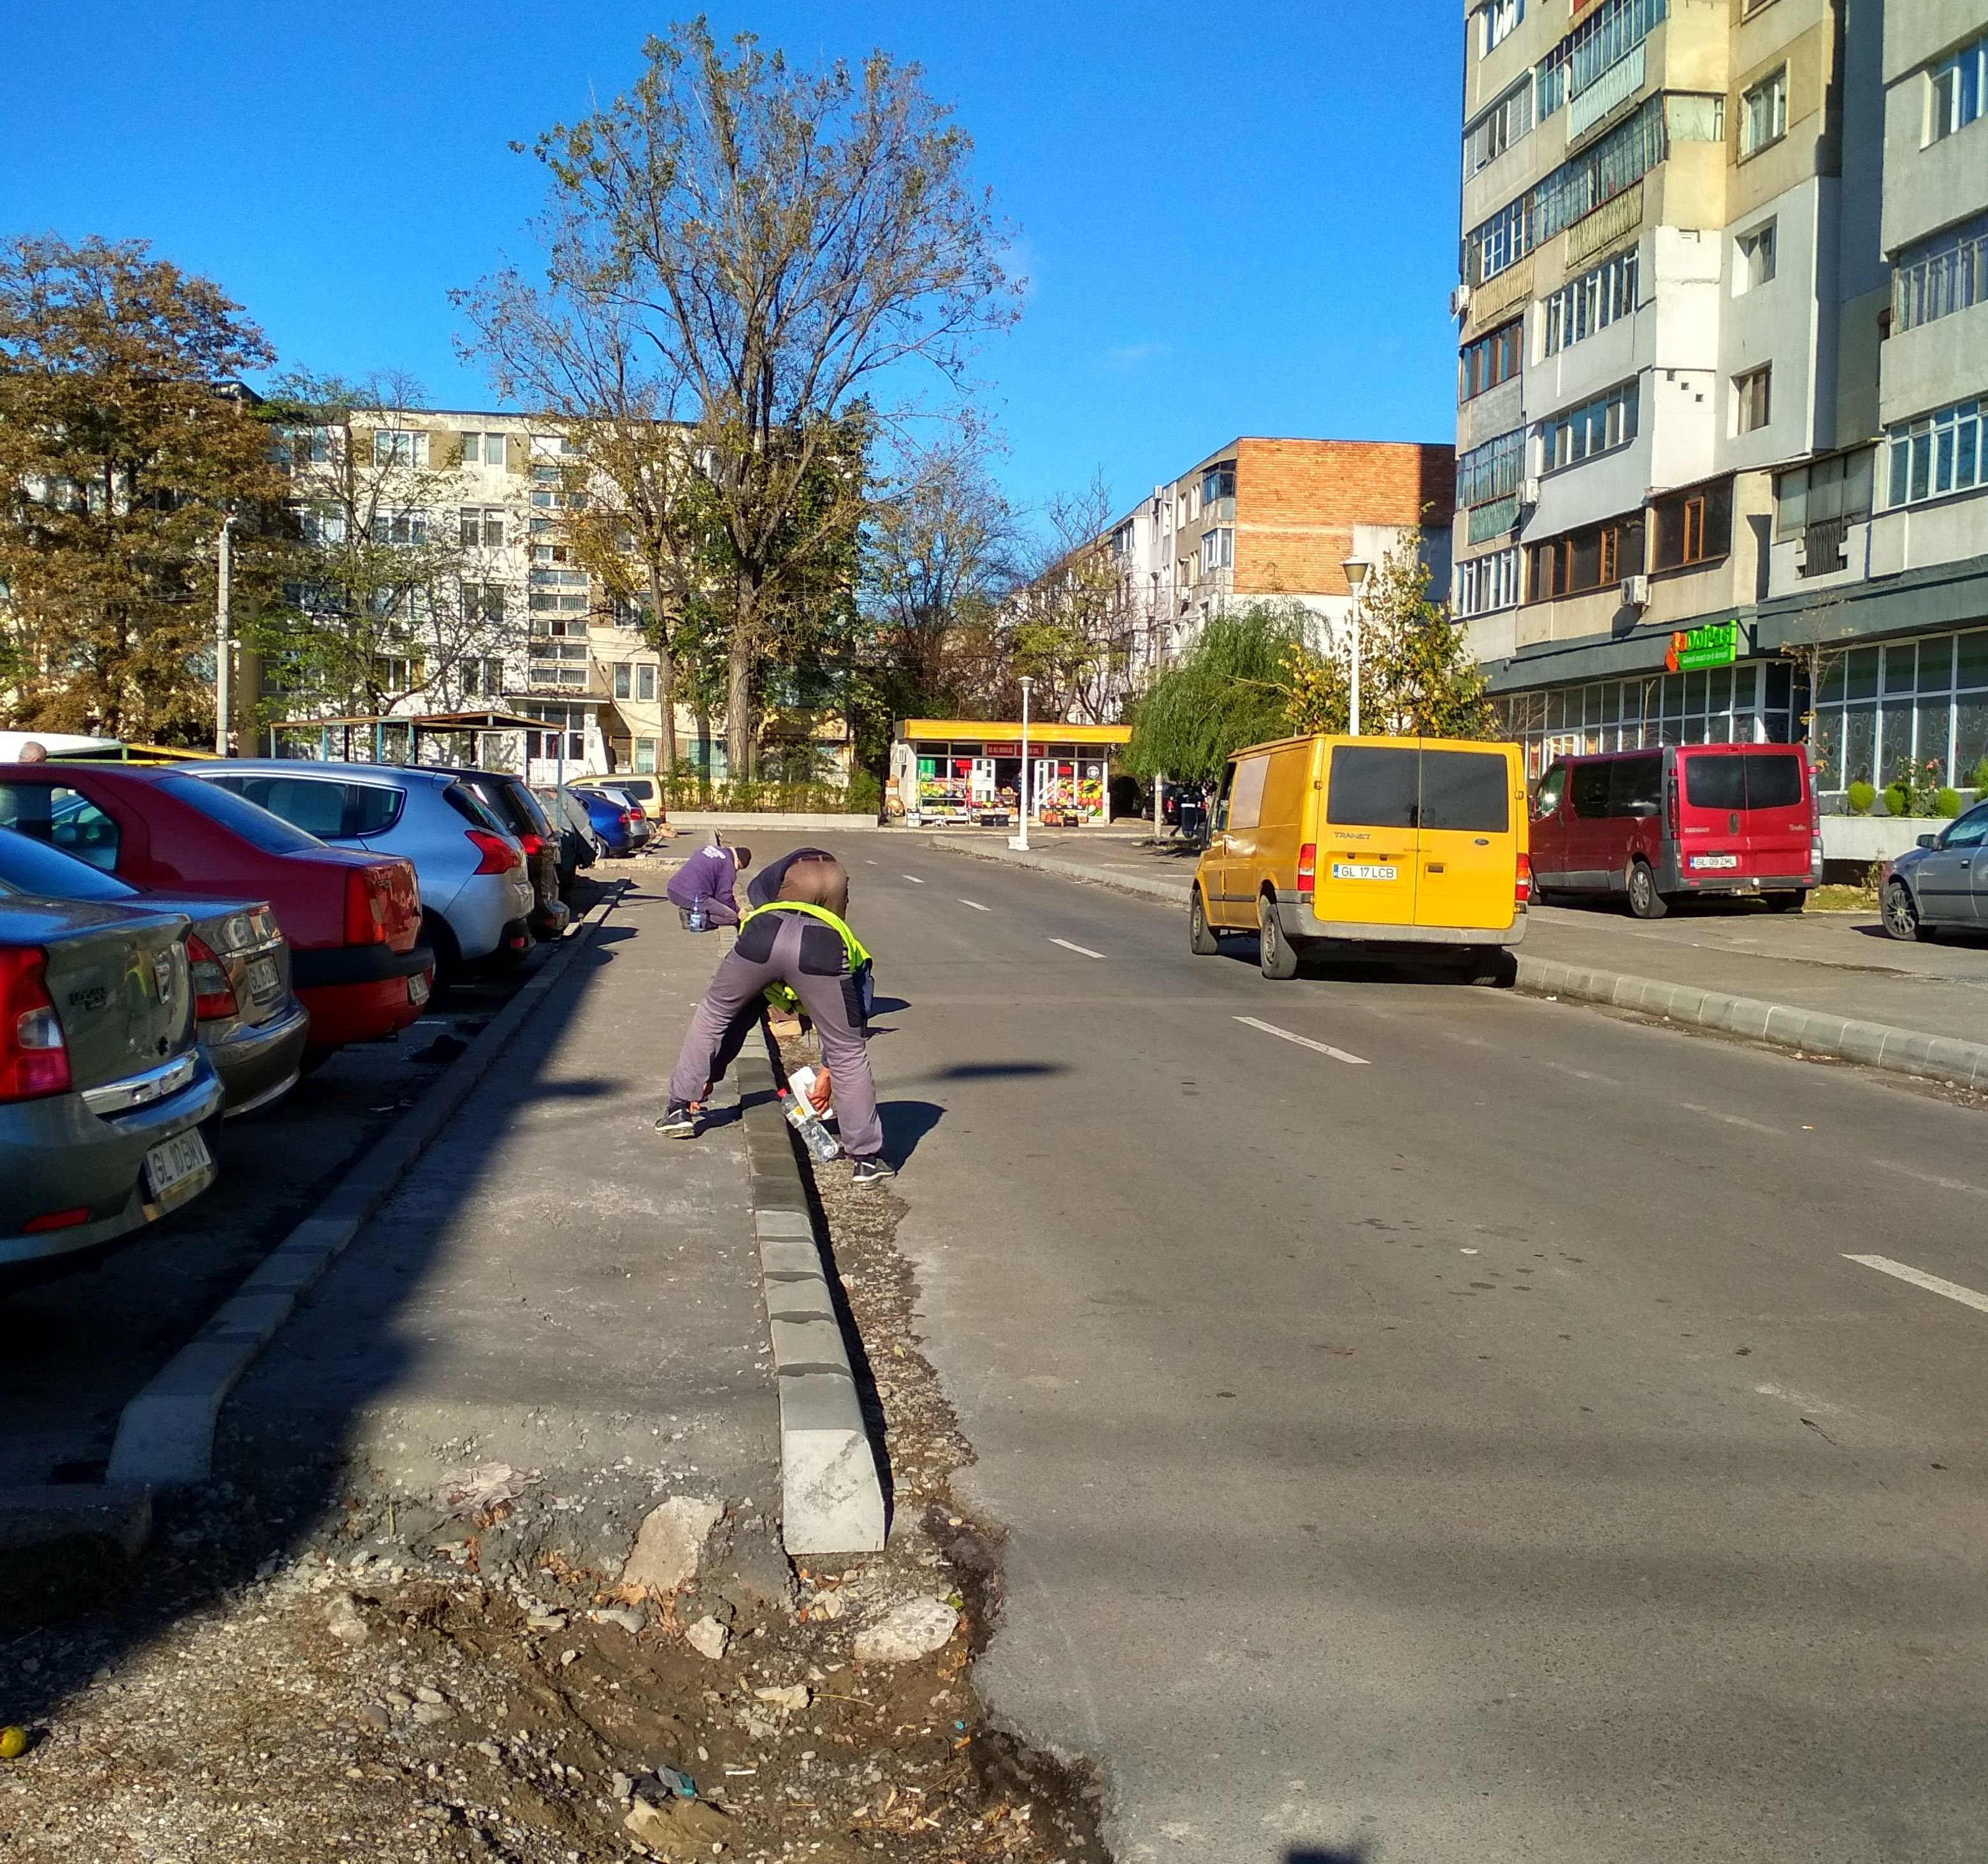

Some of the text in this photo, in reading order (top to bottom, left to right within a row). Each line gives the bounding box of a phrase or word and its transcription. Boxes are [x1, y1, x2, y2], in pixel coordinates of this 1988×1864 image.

[1334, 831, 1371, 840] TRANSIT
[1341, 866, 1394, 879] GL 17 LCB
[152, 1150, 173, 1185] GL
